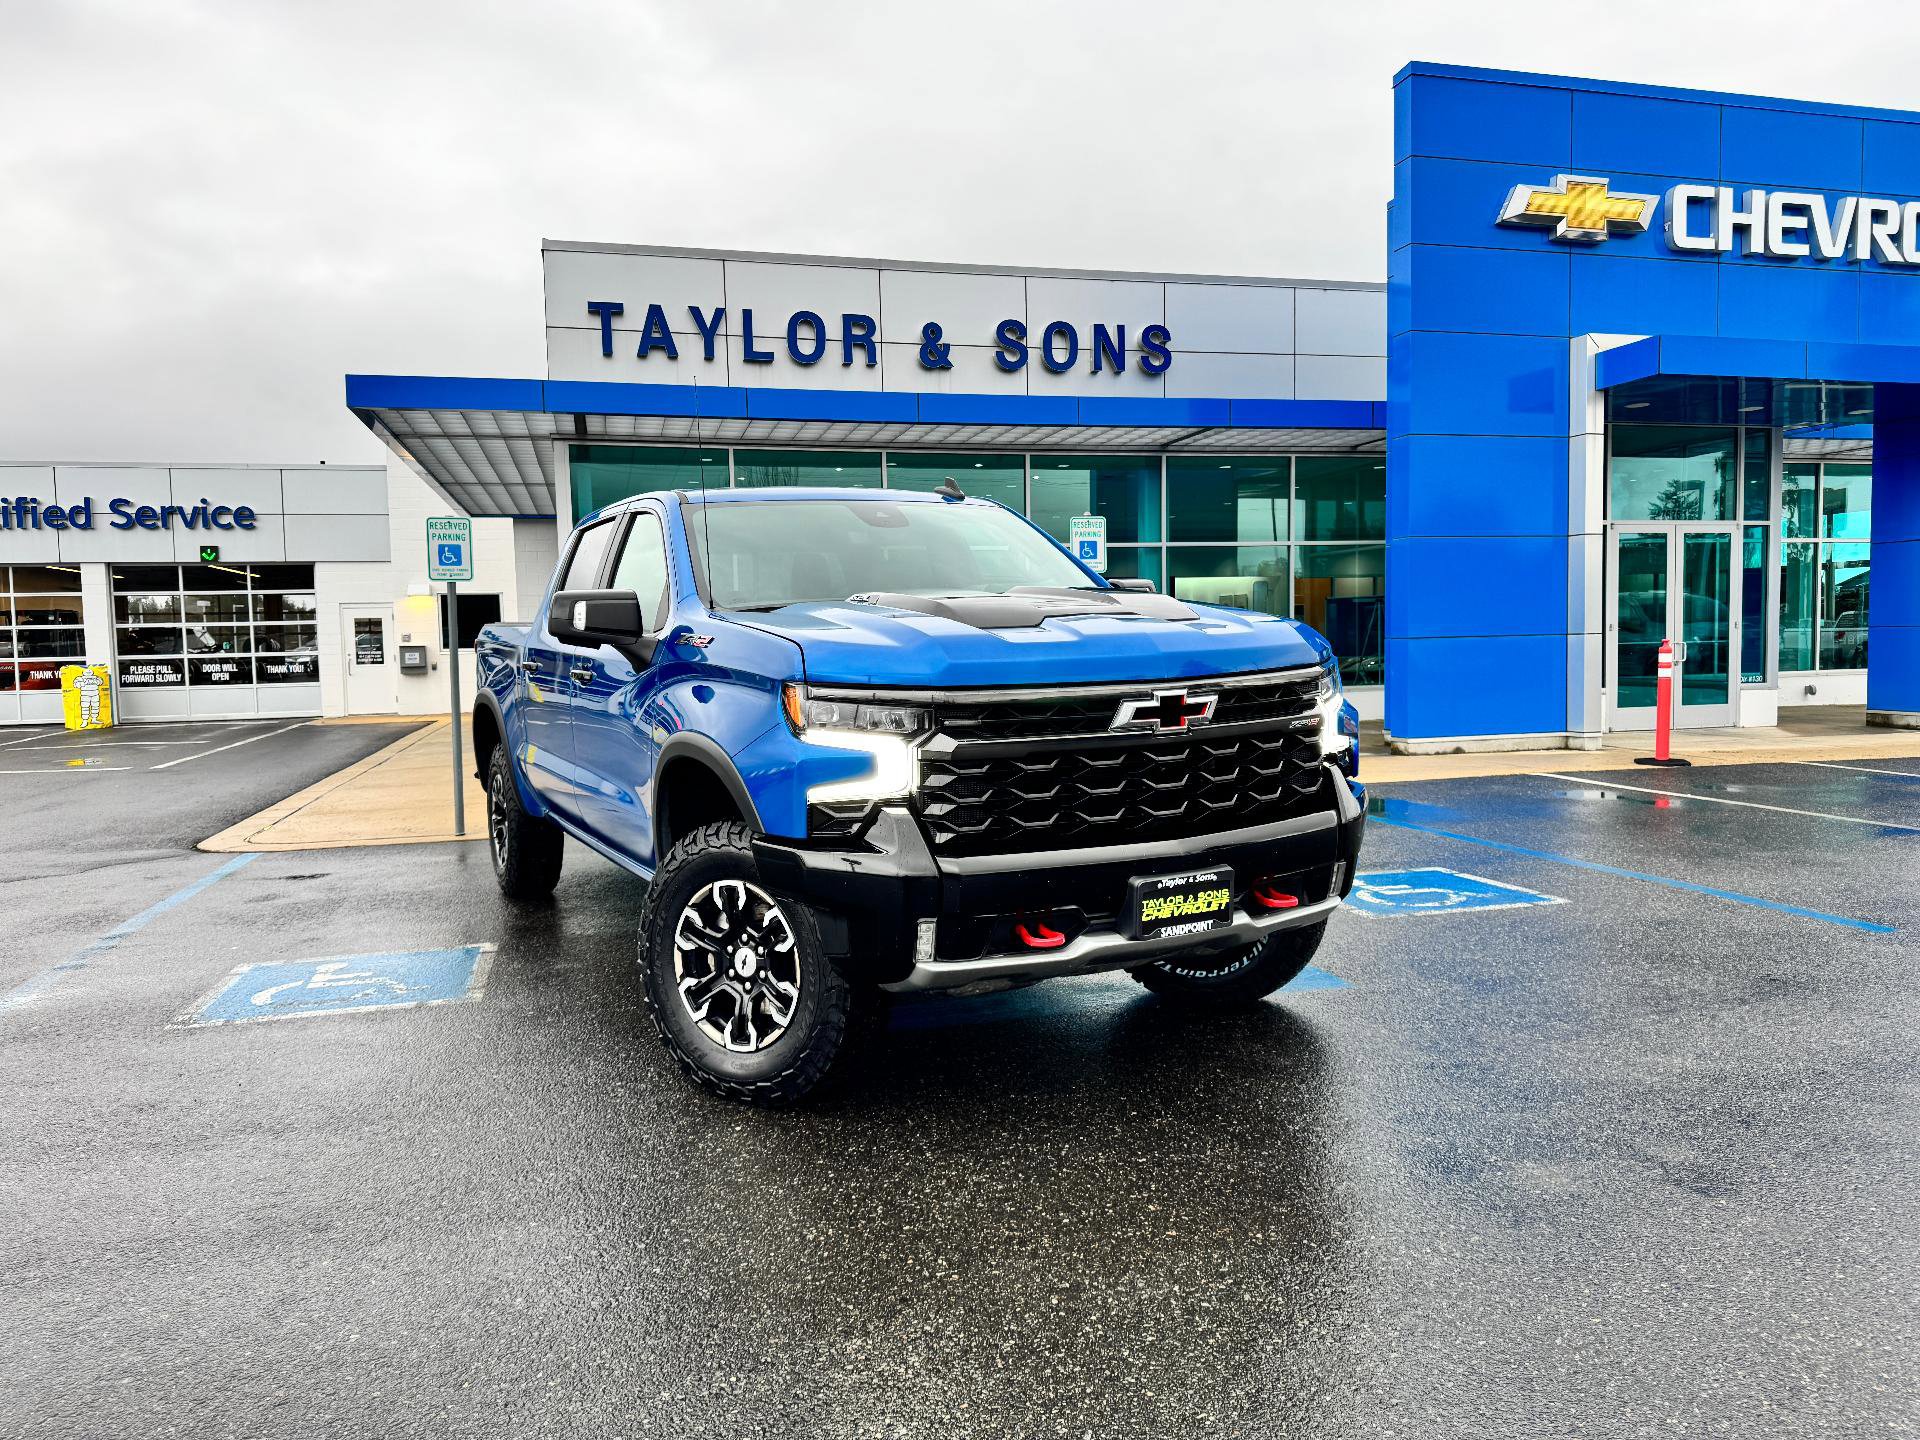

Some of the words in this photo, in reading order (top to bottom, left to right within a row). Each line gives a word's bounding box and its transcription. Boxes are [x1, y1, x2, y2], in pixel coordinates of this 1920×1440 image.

[587, 300, 878, 367] TAYLOR
[919, 321, 955, 372] &
[992, 318, 1173, 374] SONS
[0, 496, 94, 529] ified
[108, 497, 256, 529] Service
[429, 521, 468, 531] RESERVED
[1073, 521, 1103, 529] RESERVED
[431, 532, 466, 542] PARKING
[1074, 530, 1102, 538] PARKING
[129, 665, 156, 675] PLEASE
[156, 664, 173, 674] PULL
[202, 663, 221, 673] DOOR
[221, 663, 238, 672] WILL
[266, 664, 288, 674] THANK
[30, 670, 54, 680] THANK
[121, 674, 154, 684] FORWARD
[155, 673, 182, 683] SLOWLY
[211, 672, 230, 682] OPEN
[1161, 878, 1188, 889] Taylor
[1195, 873, 1214, 883] Sons
[1142, 895, 1184, 910] TAYLOR
[1187, 894, 1195, 904] &
[1197, 888, 1230, 900] SONS
[1142, 898, 1230, 921] CHEVROLET
[1160, 919, 1214, 938] SANDPOINT
